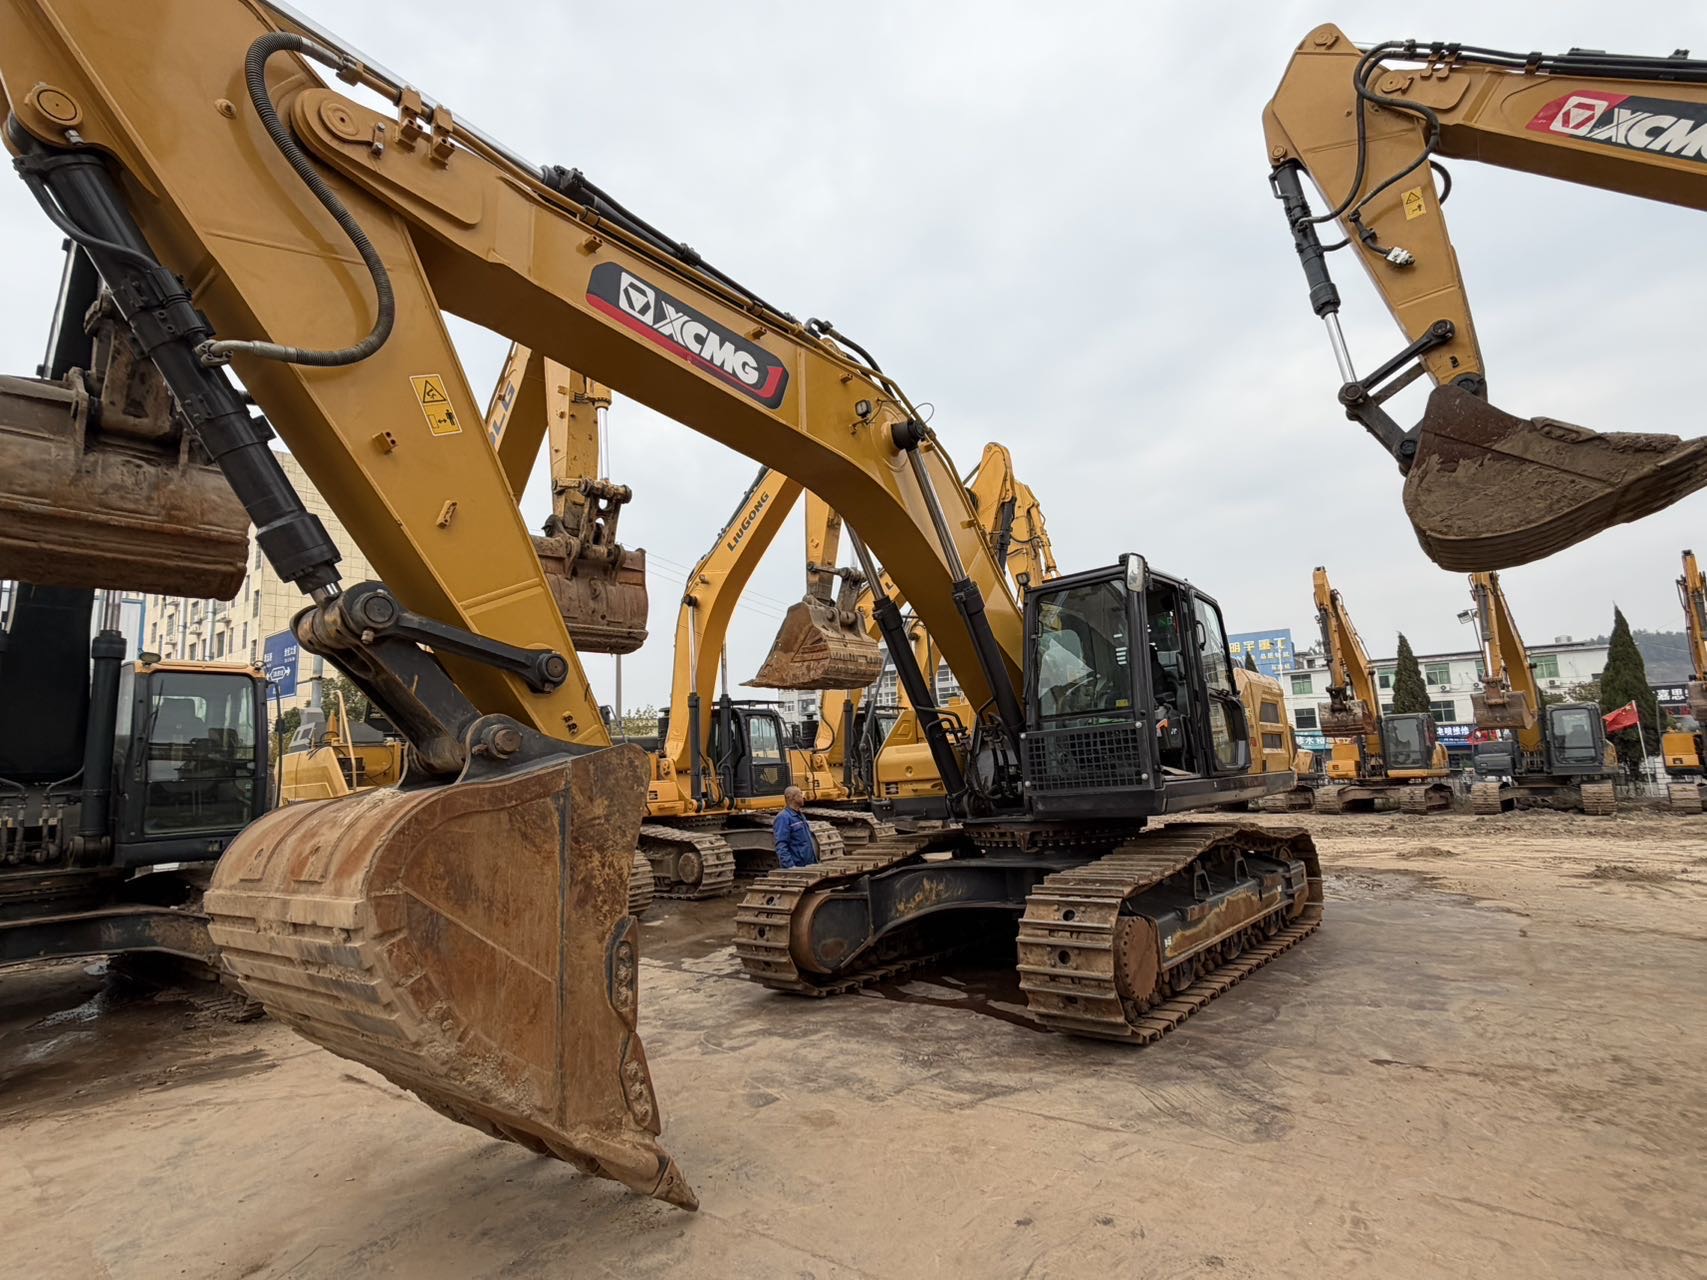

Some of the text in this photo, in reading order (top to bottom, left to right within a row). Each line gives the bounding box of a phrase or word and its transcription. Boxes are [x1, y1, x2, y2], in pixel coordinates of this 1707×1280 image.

[1586, 107, 1707, 163] XCM
[652, 300, 759, 385] XCMG
[489, 380, 516, 446] LG
[726, 491, 769, 552] LIUGONG
